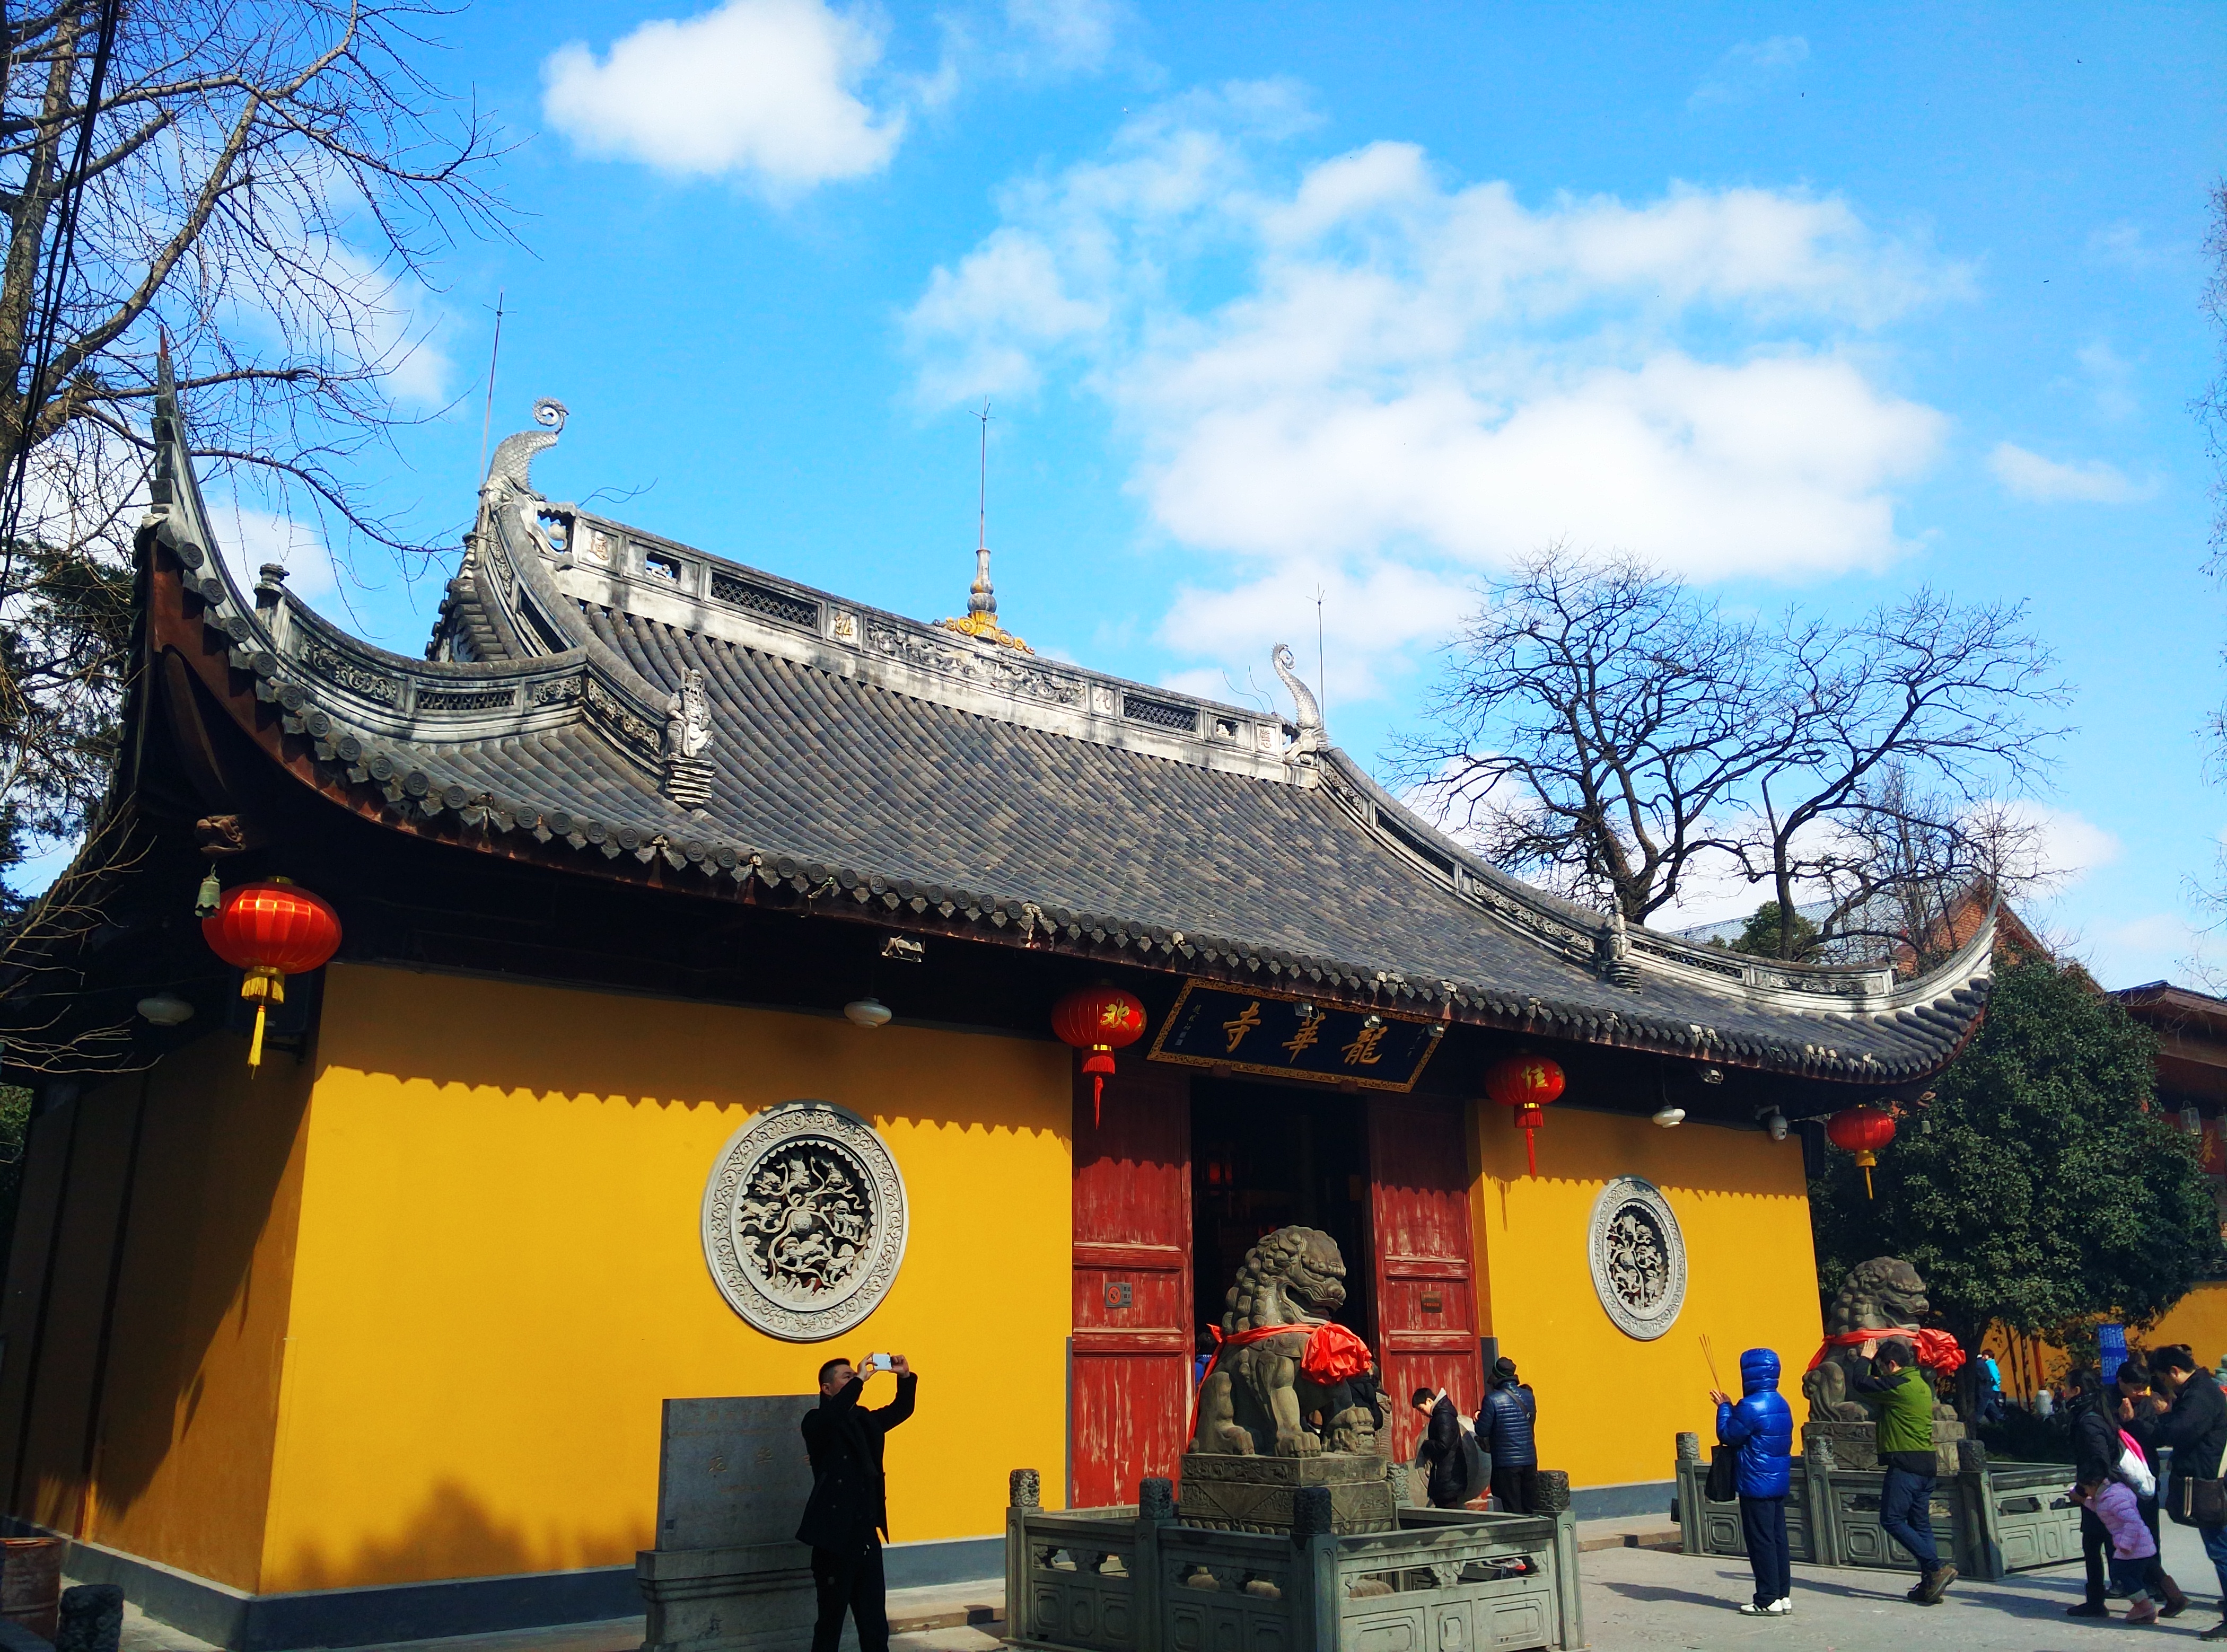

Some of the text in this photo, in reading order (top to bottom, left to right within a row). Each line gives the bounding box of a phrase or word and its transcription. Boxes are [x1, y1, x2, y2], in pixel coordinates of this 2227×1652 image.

[1100, 997, 1130, 1031] 欢
[1222, 1001, 1389, 1066] 龍華寺
[1521, 1062, 1549, 1090] 佳
